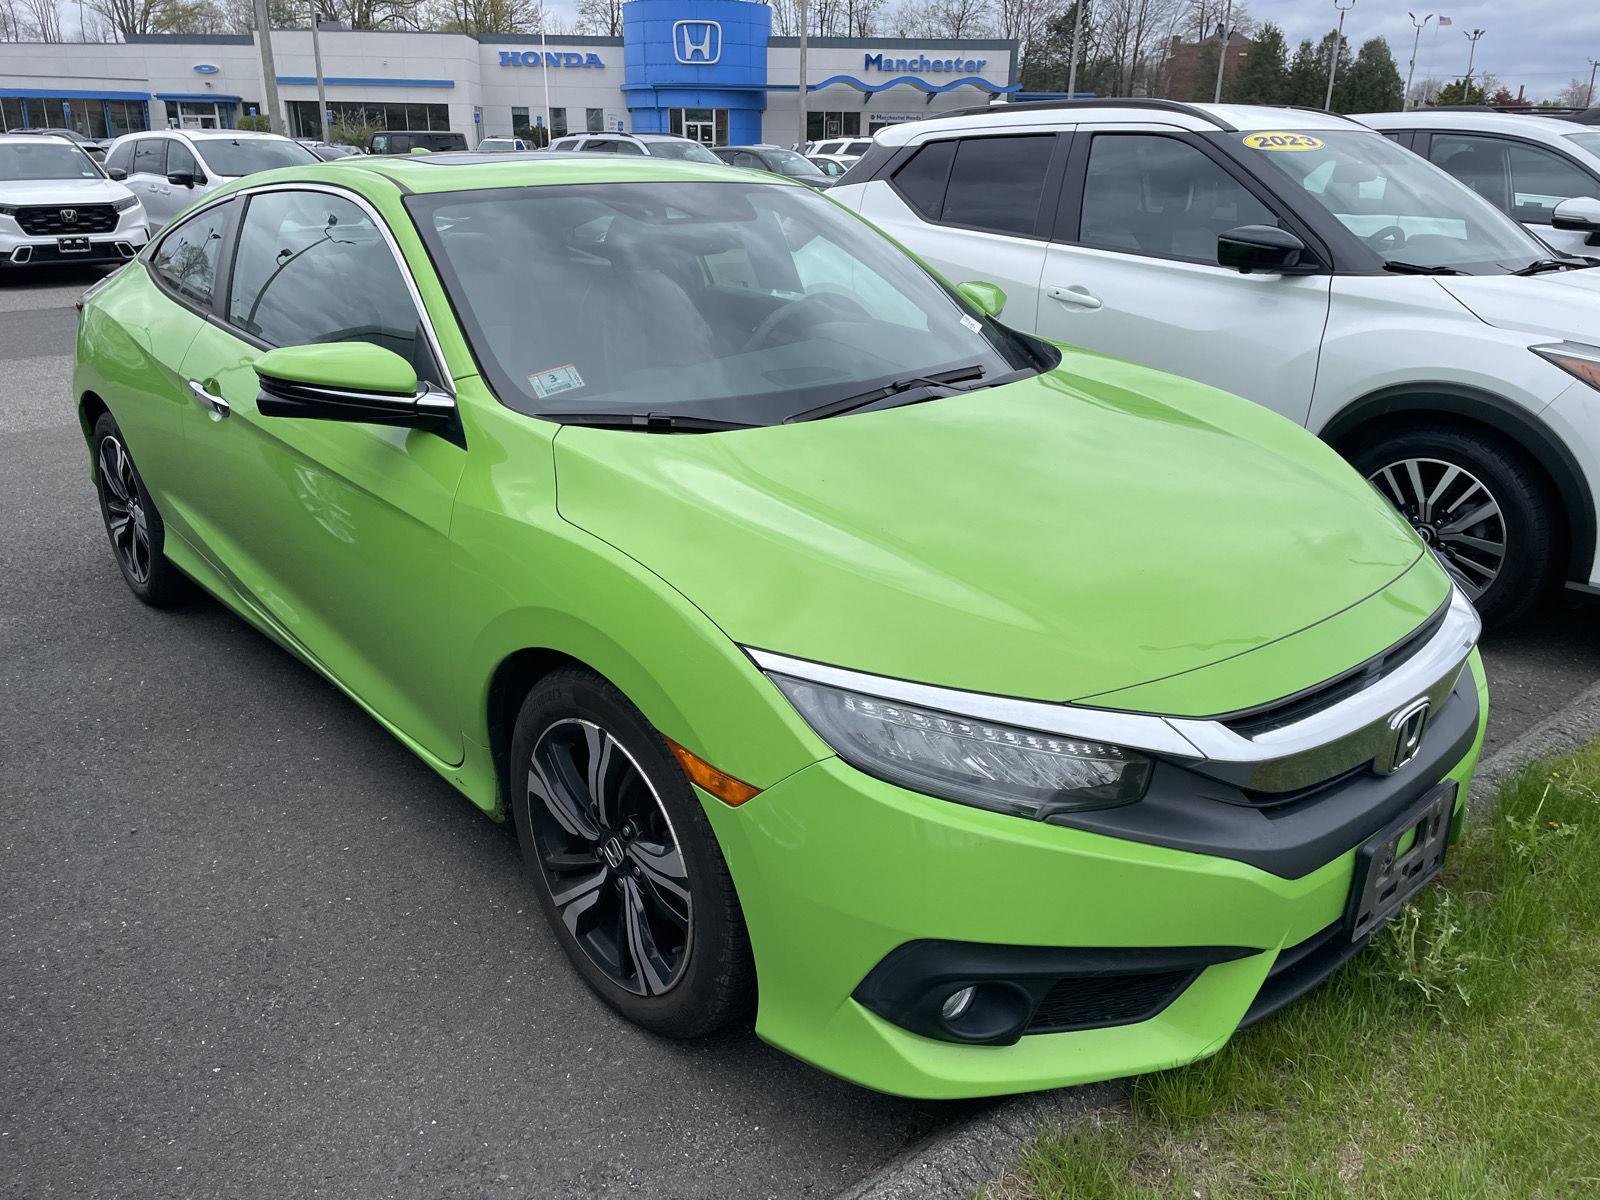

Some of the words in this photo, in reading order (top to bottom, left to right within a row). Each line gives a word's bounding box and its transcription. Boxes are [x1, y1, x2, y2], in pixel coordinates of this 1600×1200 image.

[498, 51, 606, 69] HONDA
[864, 53, 988, 73] Manchester
[1253, 135, 1318, 148] 2023
[548, 374, 557, 383] 3
